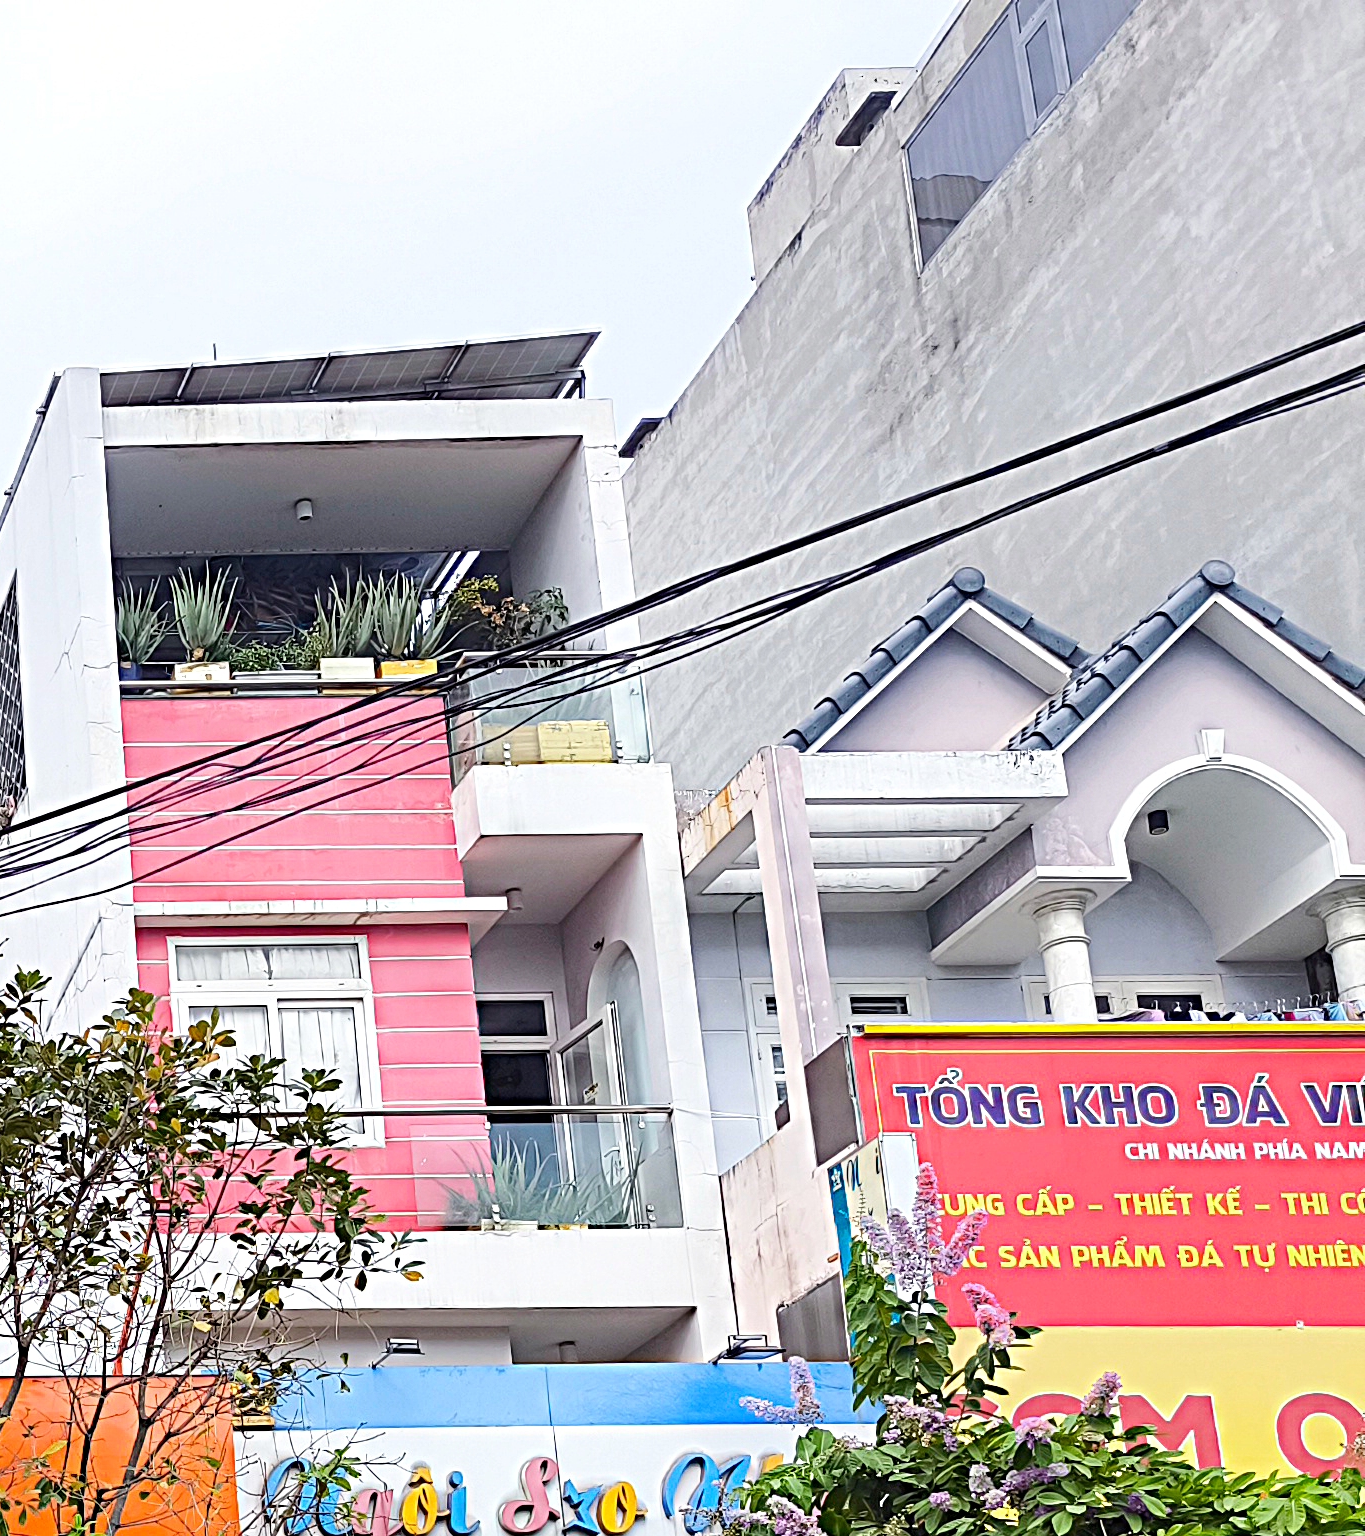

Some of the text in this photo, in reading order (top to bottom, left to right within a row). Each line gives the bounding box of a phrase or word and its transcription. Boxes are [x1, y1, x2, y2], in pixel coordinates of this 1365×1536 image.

[894, 1067, 1289, 1128] TỔNG KHO ĐÁ
[1124, 1138, 1307, 1161] CHI NHÁNH PHÍA
[1015, 1186, 1328, 1216] CẤP THIẾT KẾ THI
[1000, 1237, 1061, 1268] SẢN
[1071, 1236, 1166, 1268] PHẨM
[1177, 1239, 1224, 1268] ĐÁ
[1233, 1241, 1276, 1273] TỰ
